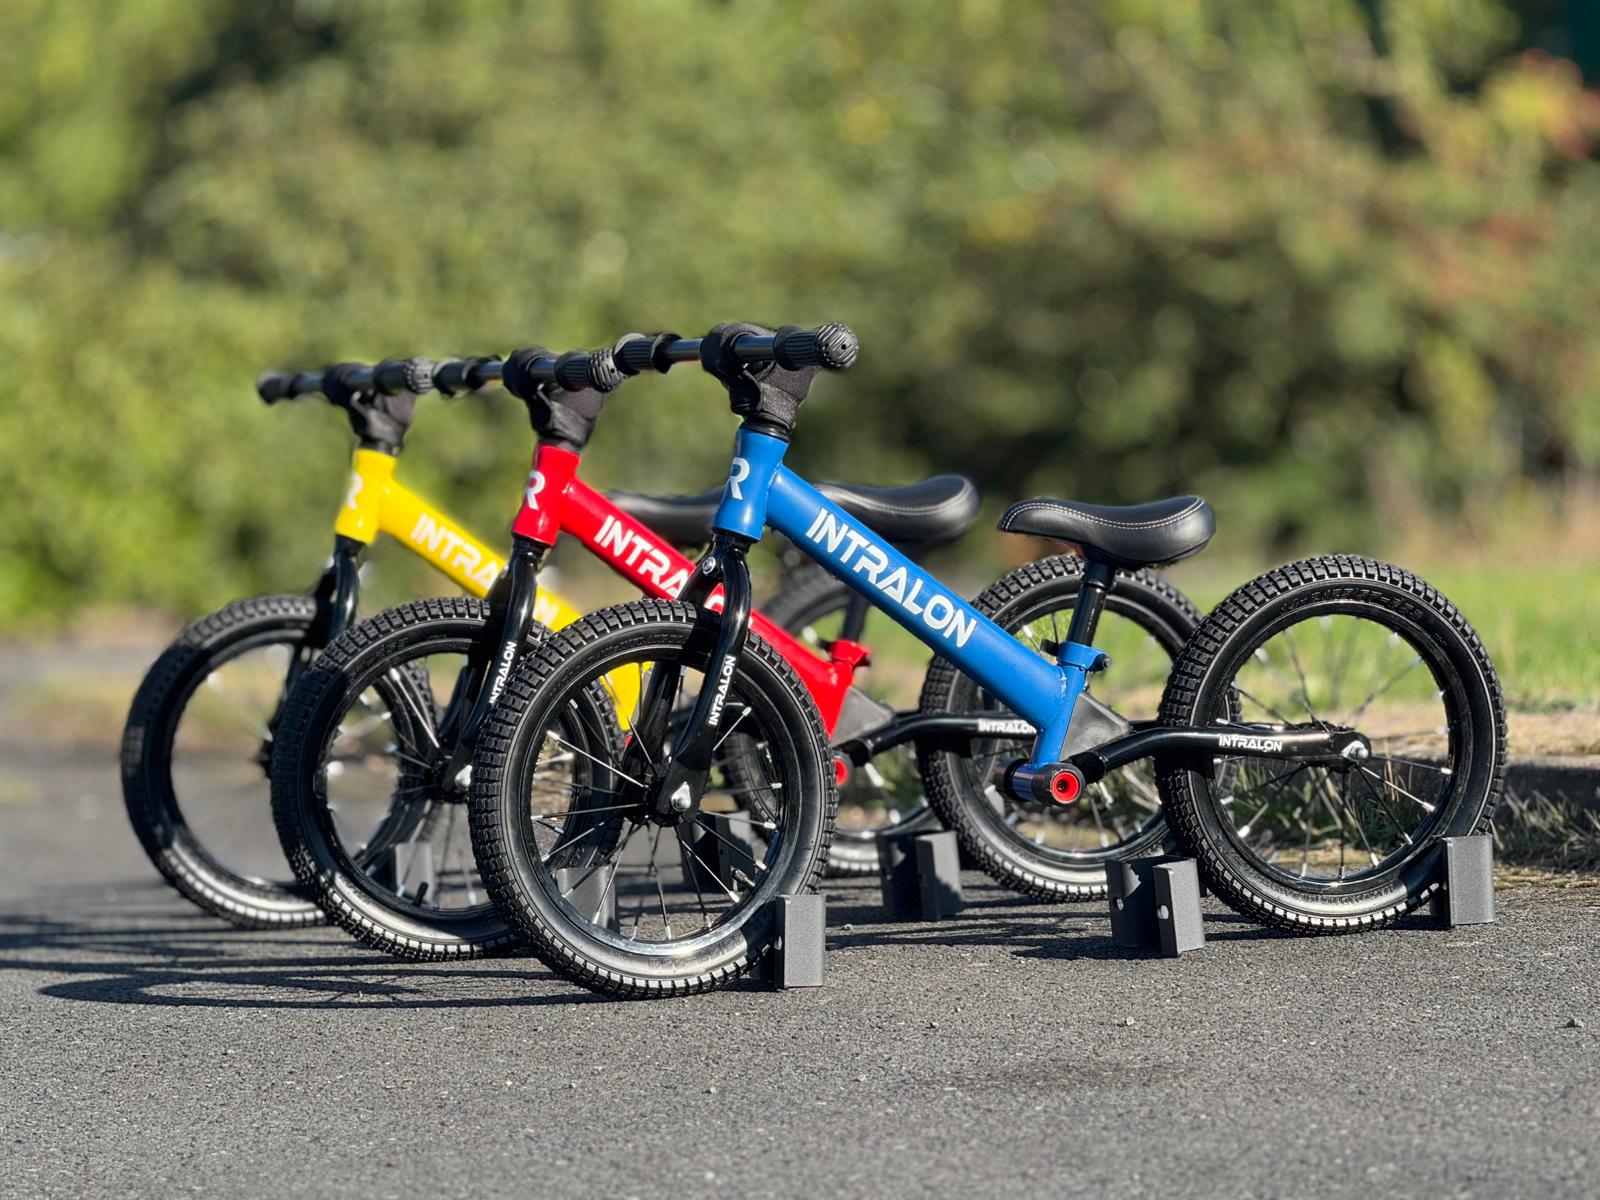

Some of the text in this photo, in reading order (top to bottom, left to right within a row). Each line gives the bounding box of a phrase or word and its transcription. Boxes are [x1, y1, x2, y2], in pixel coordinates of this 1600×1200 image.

[527, 470, 546, 510] R
[730, 457, 750, 500] R
[410, 512, 560, 627] INTRAN
[805, 507, 977, 648] INTRALON
[707, 654, 737, 726] INTRALON
[1218, 734, 1283, 752] INTRALON
